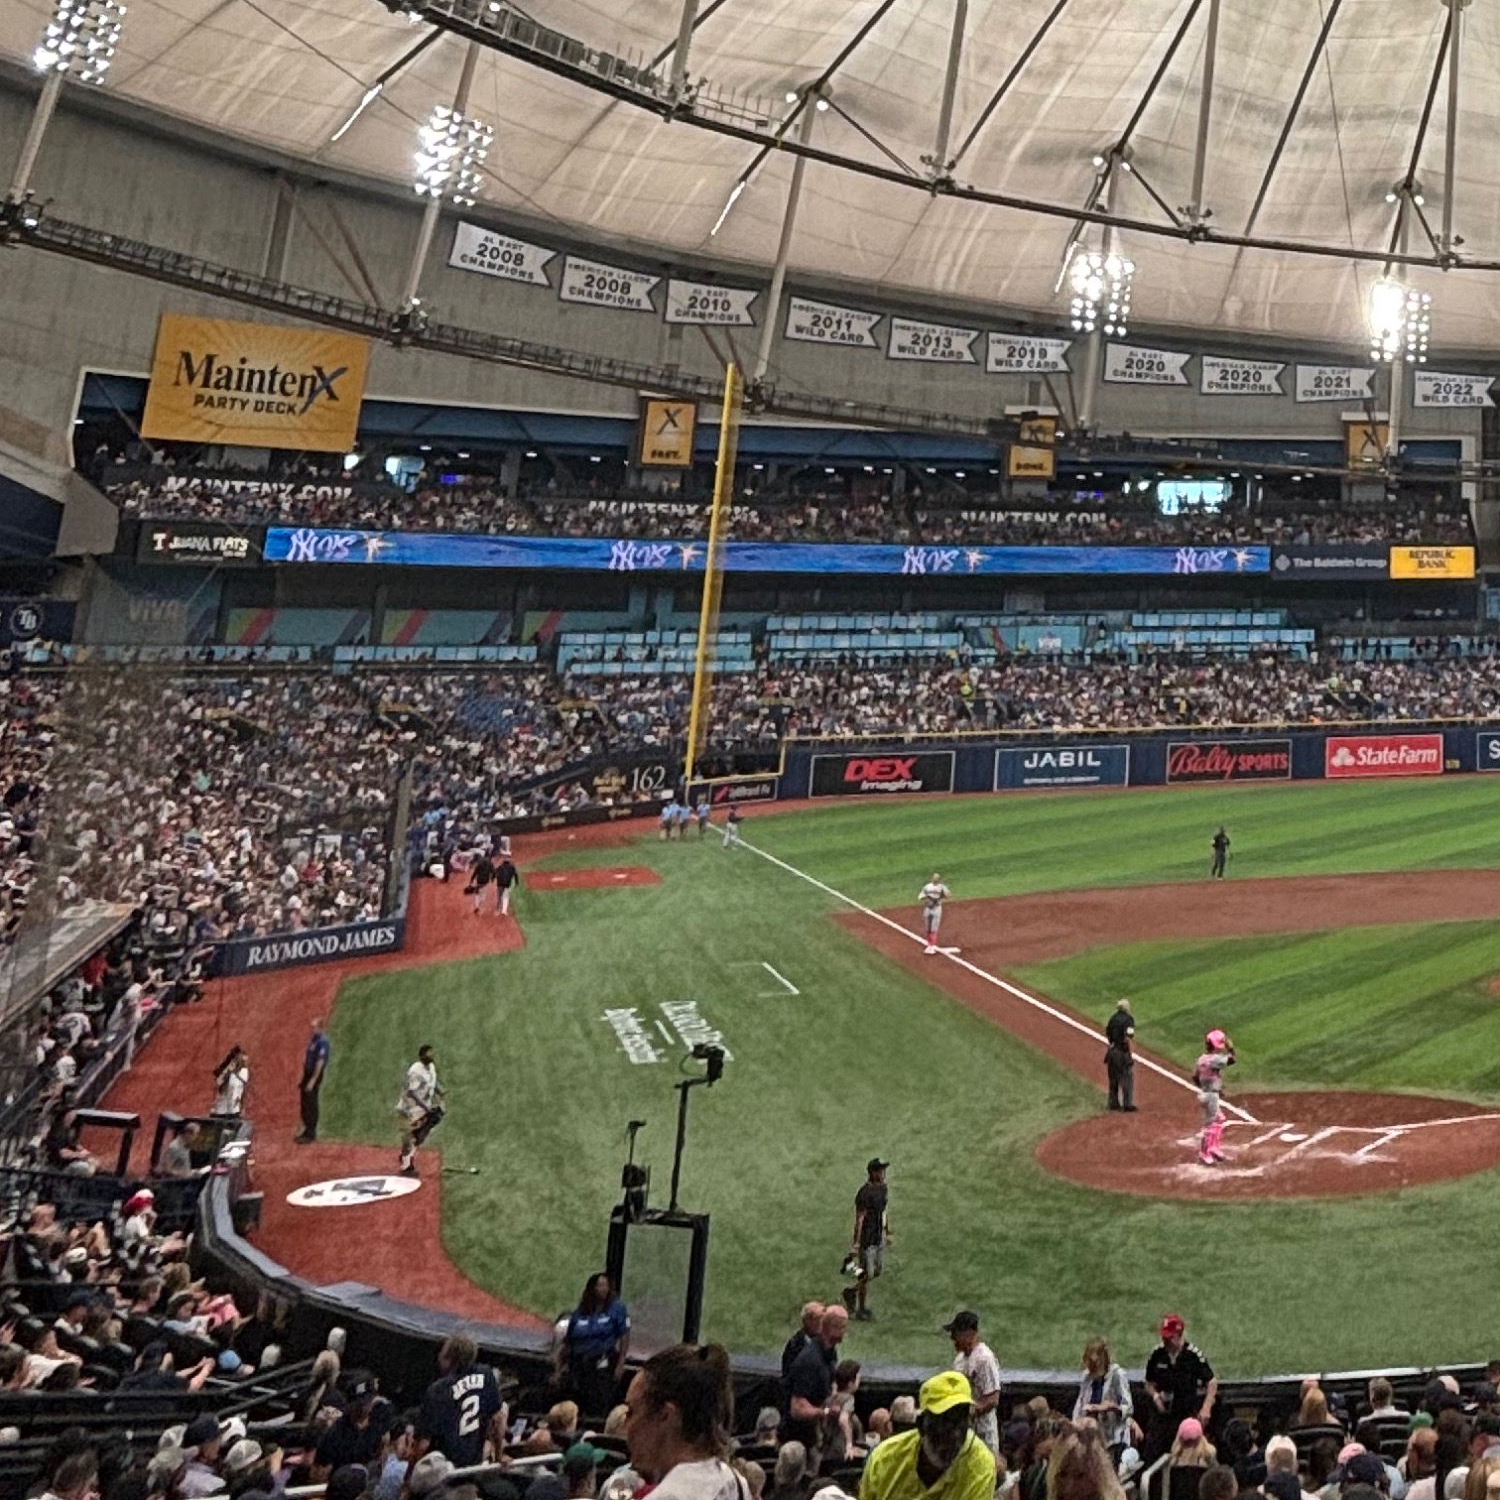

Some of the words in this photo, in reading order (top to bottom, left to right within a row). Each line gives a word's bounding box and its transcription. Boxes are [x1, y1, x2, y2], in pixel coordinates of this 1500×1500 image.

[476, 243, 524, 266] 2008
[460, 253, 534, 280] CHAMPIONS
[584, 274, 631, 295] 2008
[569, 286, 642, 307] CHAMPIONS
[688, 296, 732, 311] 2010
[675, 309, 741, 323] CHAMPIONS
[811, 315, 852, 332] 2011
[795, 324, 826, 338] WILD
[830, 329, 865, 344] CARD
[911, 333, 953, 349] 2013
[897, 345, 927, 357] WILD
[931, 347, 964, 360] CARD
[1006, 346, 1048, 360] 2019
[994, 358, 1023, 369] WILD
[1027, 359, 1059, 370] CARD
[1125, 358, 1166, 373] 2020
[1112, 369, 1176, 383] CHAMPIONS
[1219, 369, 1262, 383] 2020
[1313, 375, 1351, 389] 2021
[1207, 380, 1273, 393] CHAMPIONS
[1302, 388, 1365, 399] CHAMPIONS
[1432, 382, 1474, 396] 2022
[193, 393, 250, 411] PARTY
[253, 396, 298, 415] DECK
[1421, 393, 1450, 404] WILD
[1453, 395, 1484, 406] CARD
[213, 536, 249, 551] FLATS
[1408, 549, 1456, 559] REPUBLIC
[1417, 559, 1447, 569] BANK
[129, 601, 180, 622] VIVA
[1024, 751, 1101, 768] JABIL
[1169, 744, 1237, 779] Bally
[1238, 752, 1288, 772] SPORTS
[844, 758, 917, 781] DEX
[631, 765, 666, 792] 162
[860, 778, 922, 791] imaging
[246, 934, 339, 967] RAYMOND
[340, 926, 396, 952] JAMES
[459, 1394, 480, 1436] 2
